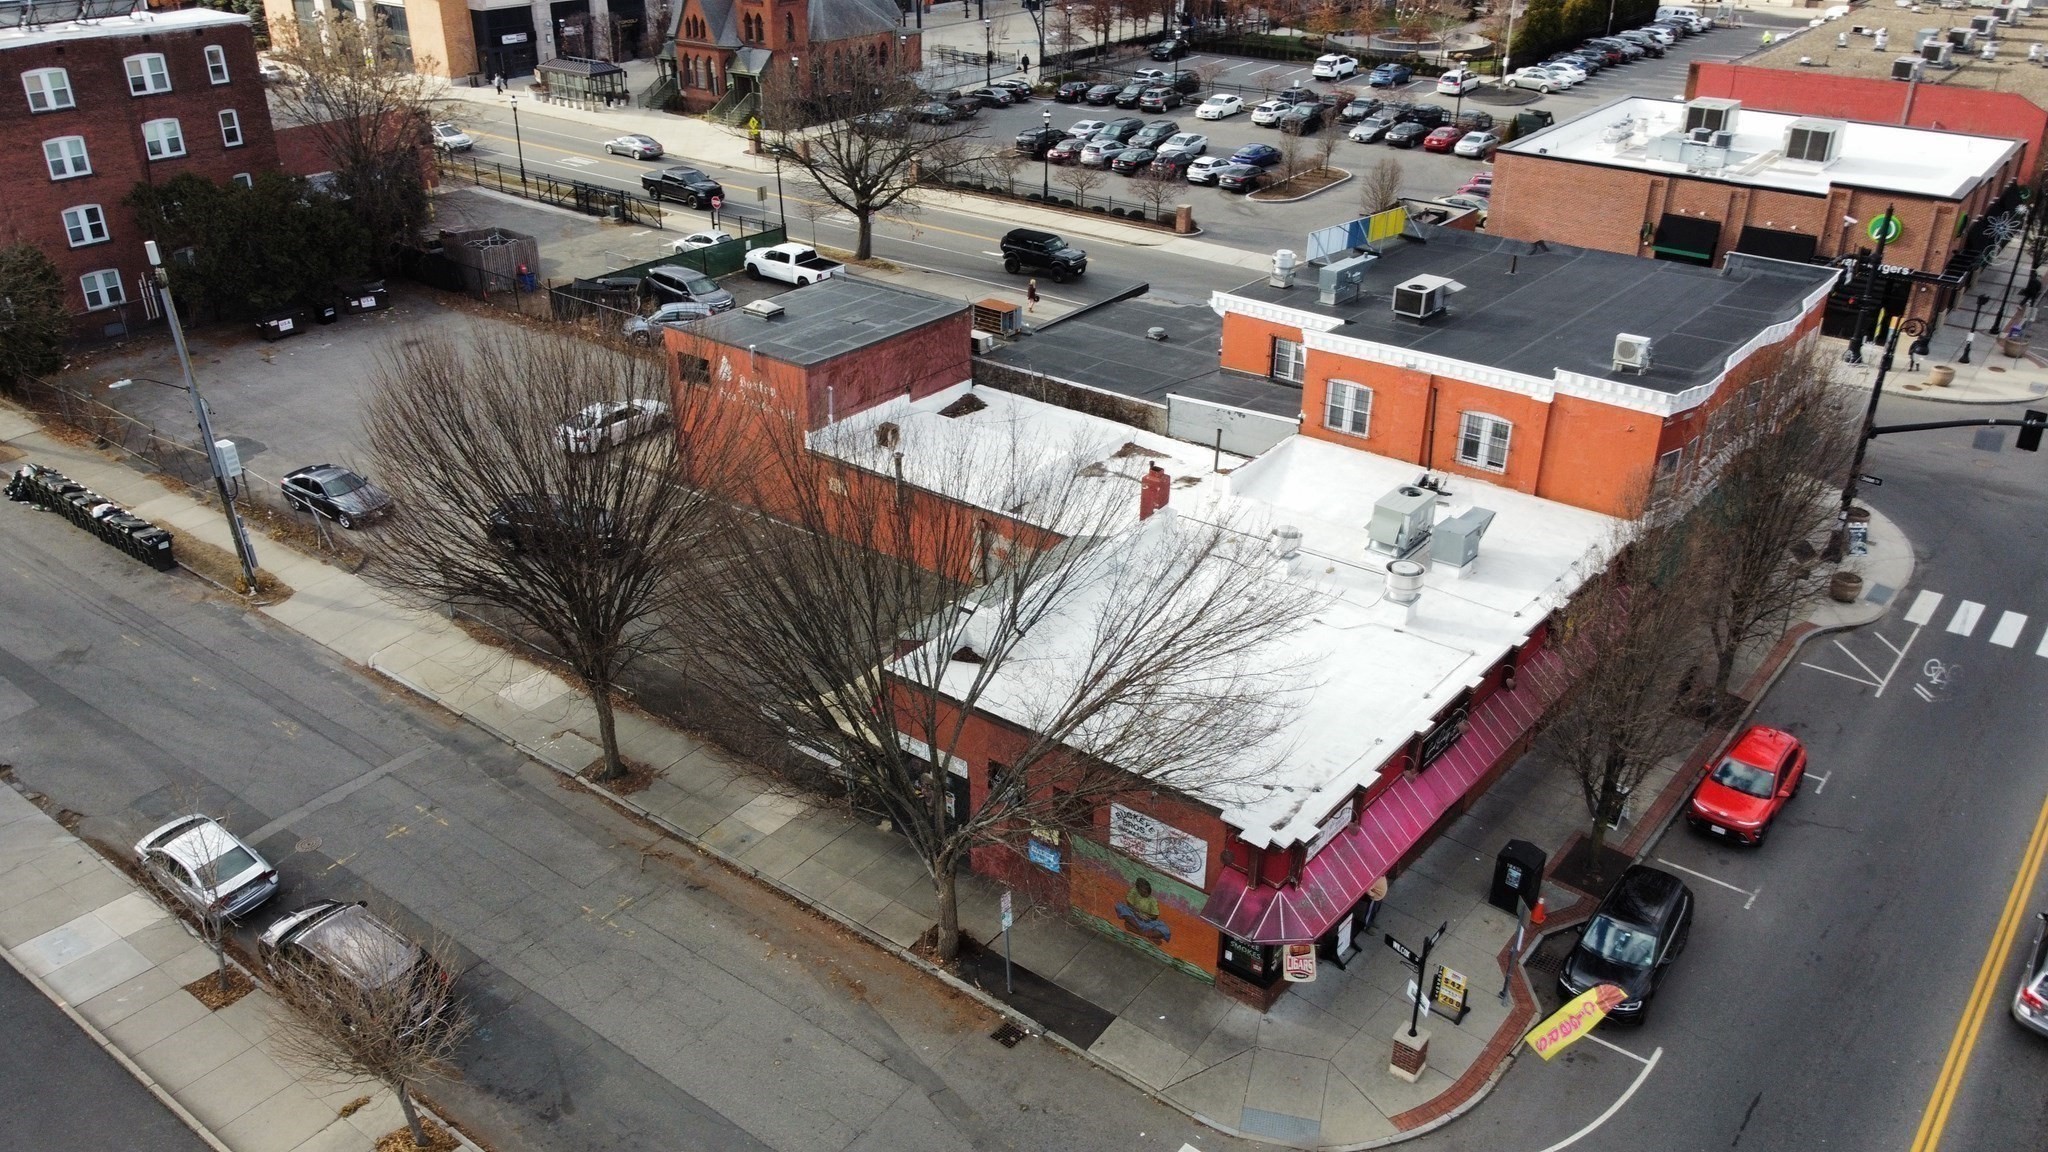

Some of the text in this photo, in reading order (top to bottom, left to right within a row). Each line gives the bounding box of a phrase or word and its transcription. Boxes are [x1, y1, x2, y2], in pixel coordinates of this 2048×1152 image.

[1115, 810, 1156, 834] BUCKEYE
[1122, 818, 1146, 834] BROS
[1230, 940, 1261, 960] SMOKES
[1392, 940, 1411, 959] WILCOX
